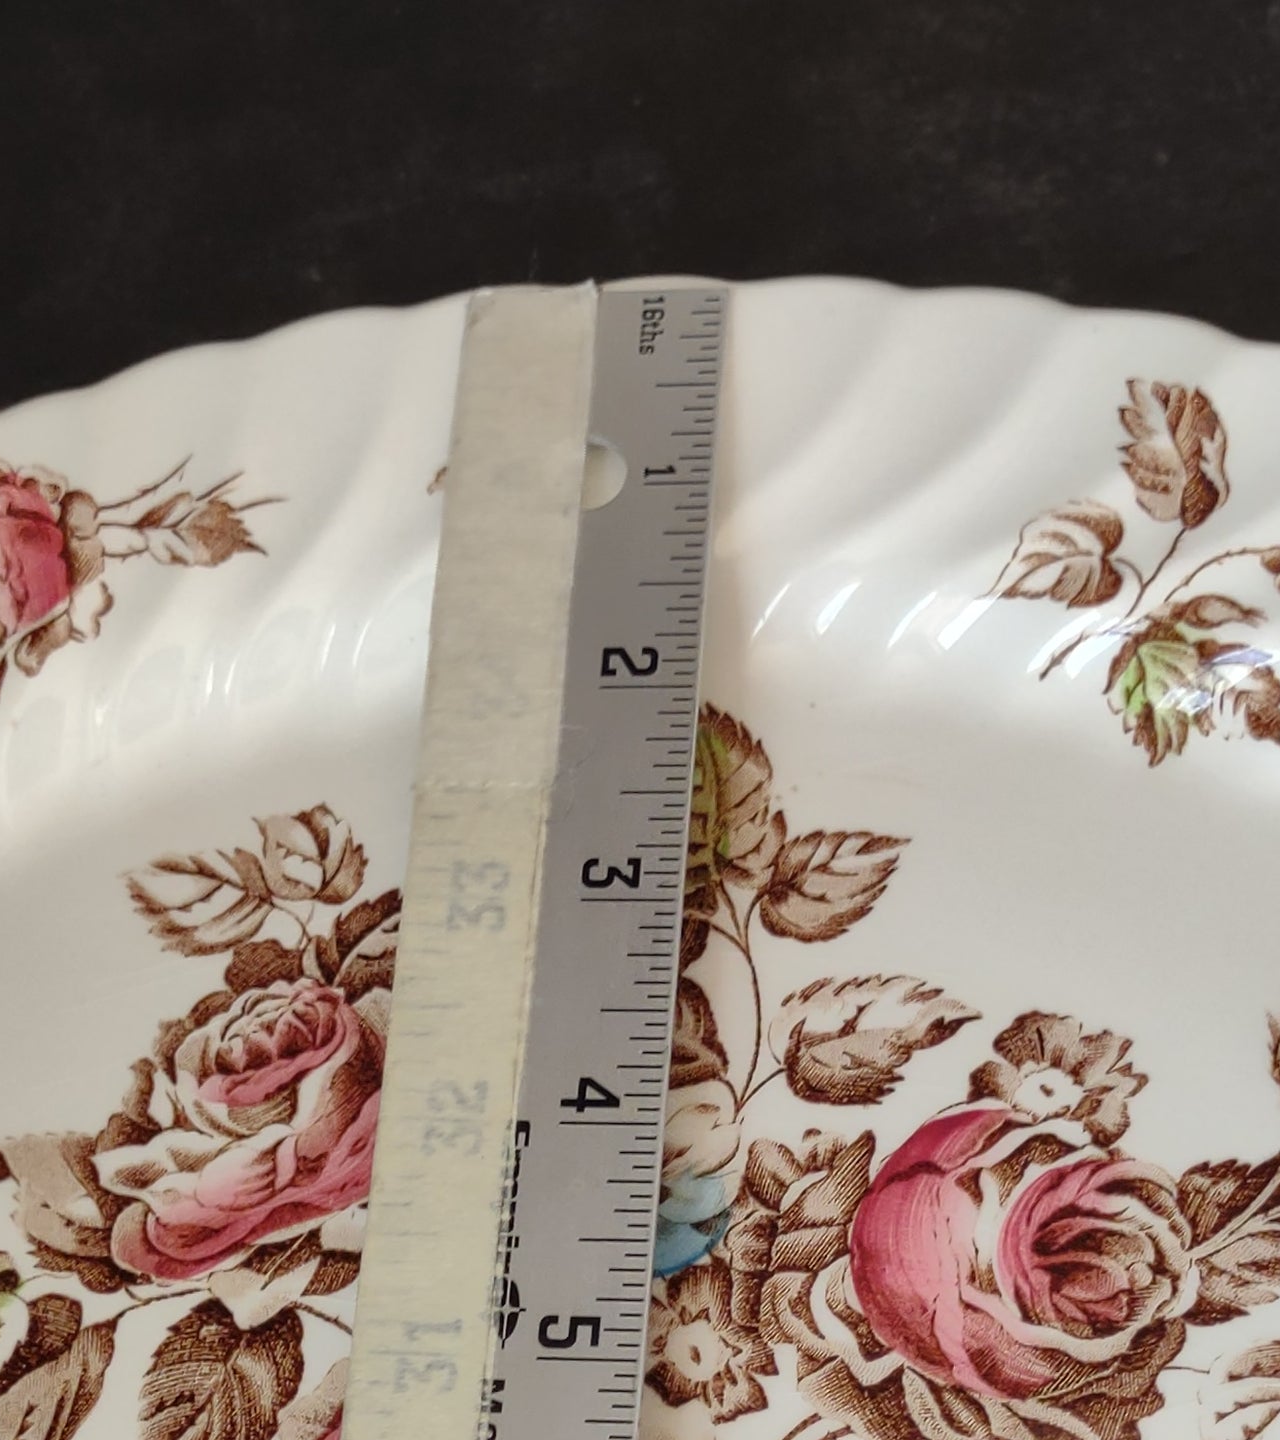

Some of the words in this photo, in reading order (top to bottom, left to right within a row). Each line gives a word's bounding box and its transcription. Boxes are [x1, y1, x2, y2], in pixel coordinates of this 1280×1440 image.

[638, 296, 665, 355] 16ths
[643, 465, 676, 478] 1
[600, 646, 659, 677] 2
[581, 857, 642, 889] 3
[447, 858, 511, 931] 33
[560, 1077, 620, 1113] 4
[538, 1315, 602, 1348] 5
